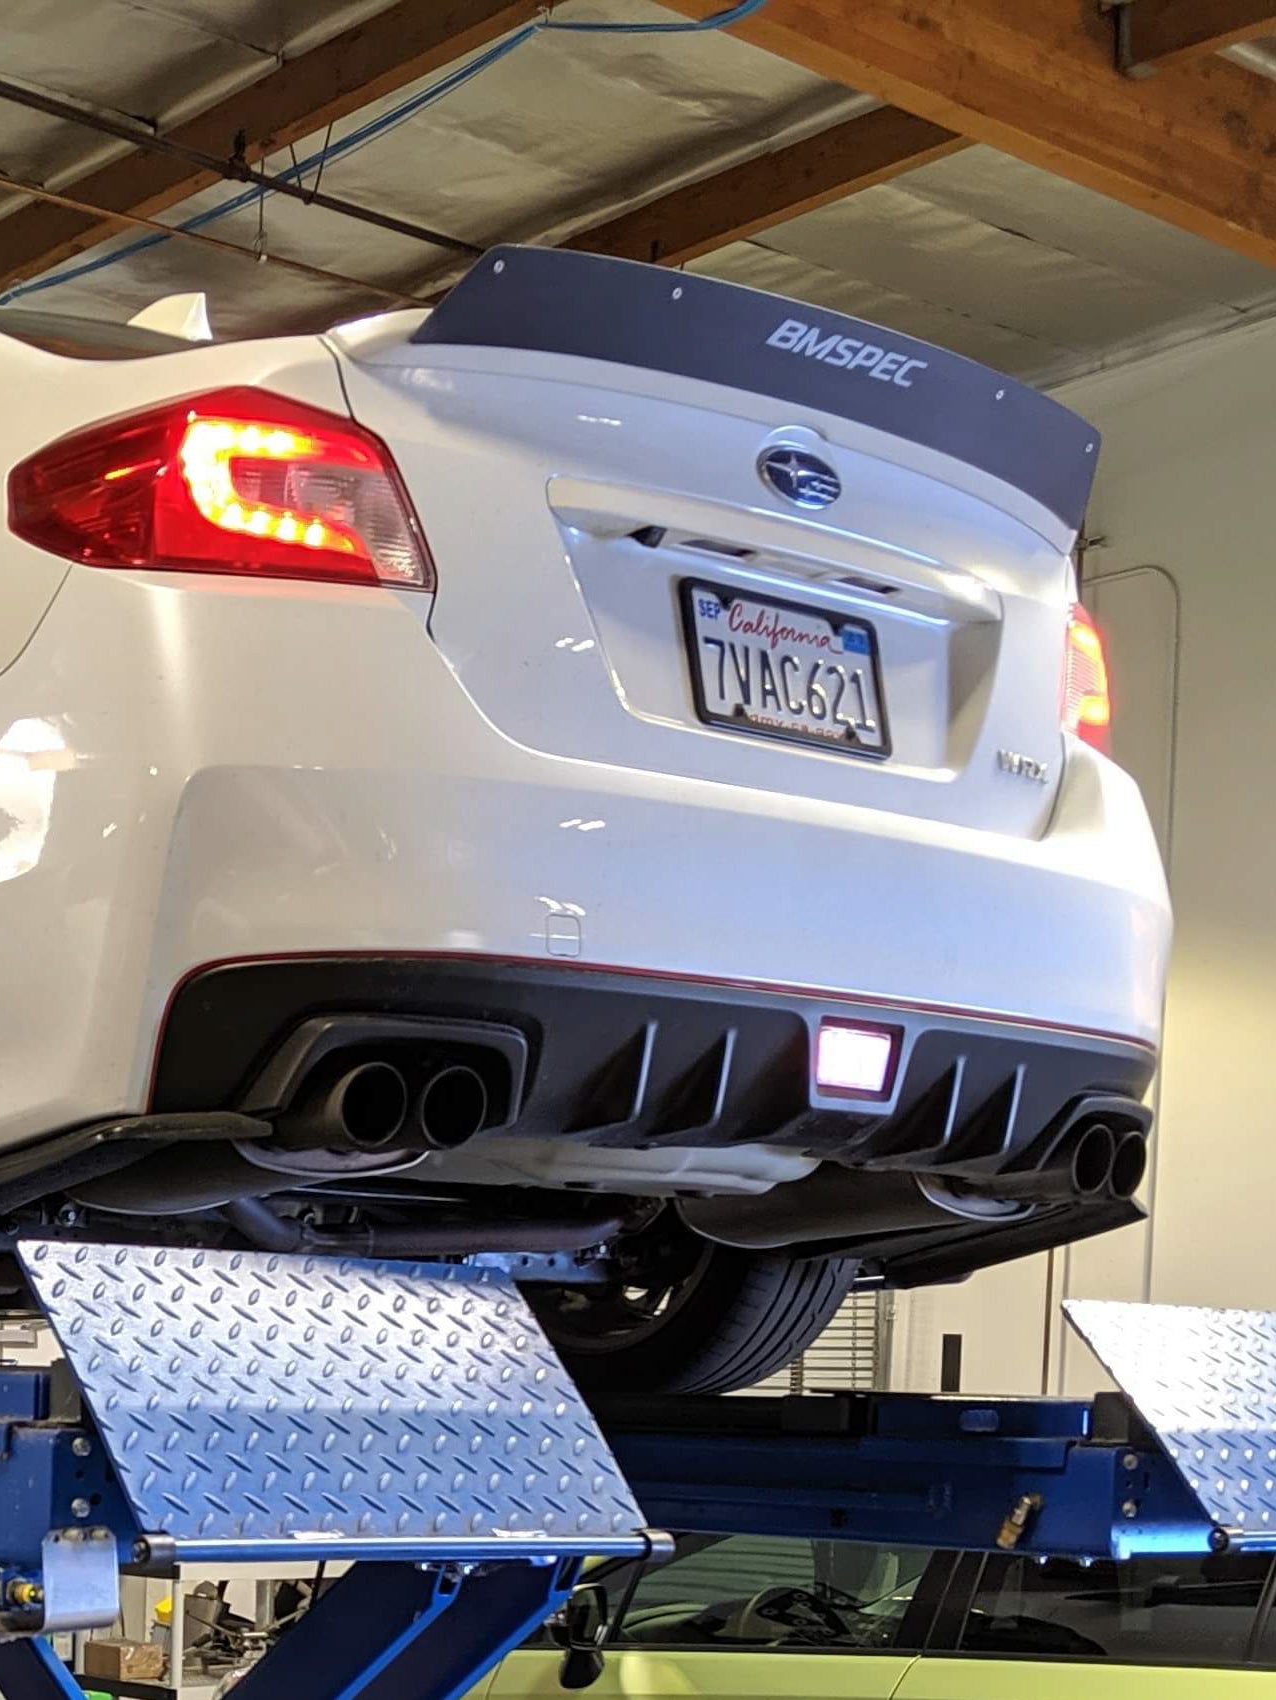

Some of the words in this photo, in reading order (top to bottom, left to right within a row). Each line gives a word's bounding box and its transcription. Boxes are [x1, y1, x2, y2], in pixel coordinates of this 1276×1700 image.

[766, 318, 928, 388] BMSPEC
[698, 598, 721, 620] SEP
[728, 602, 844, 655] California
[703, 635, 877, 733] 7VAC621
